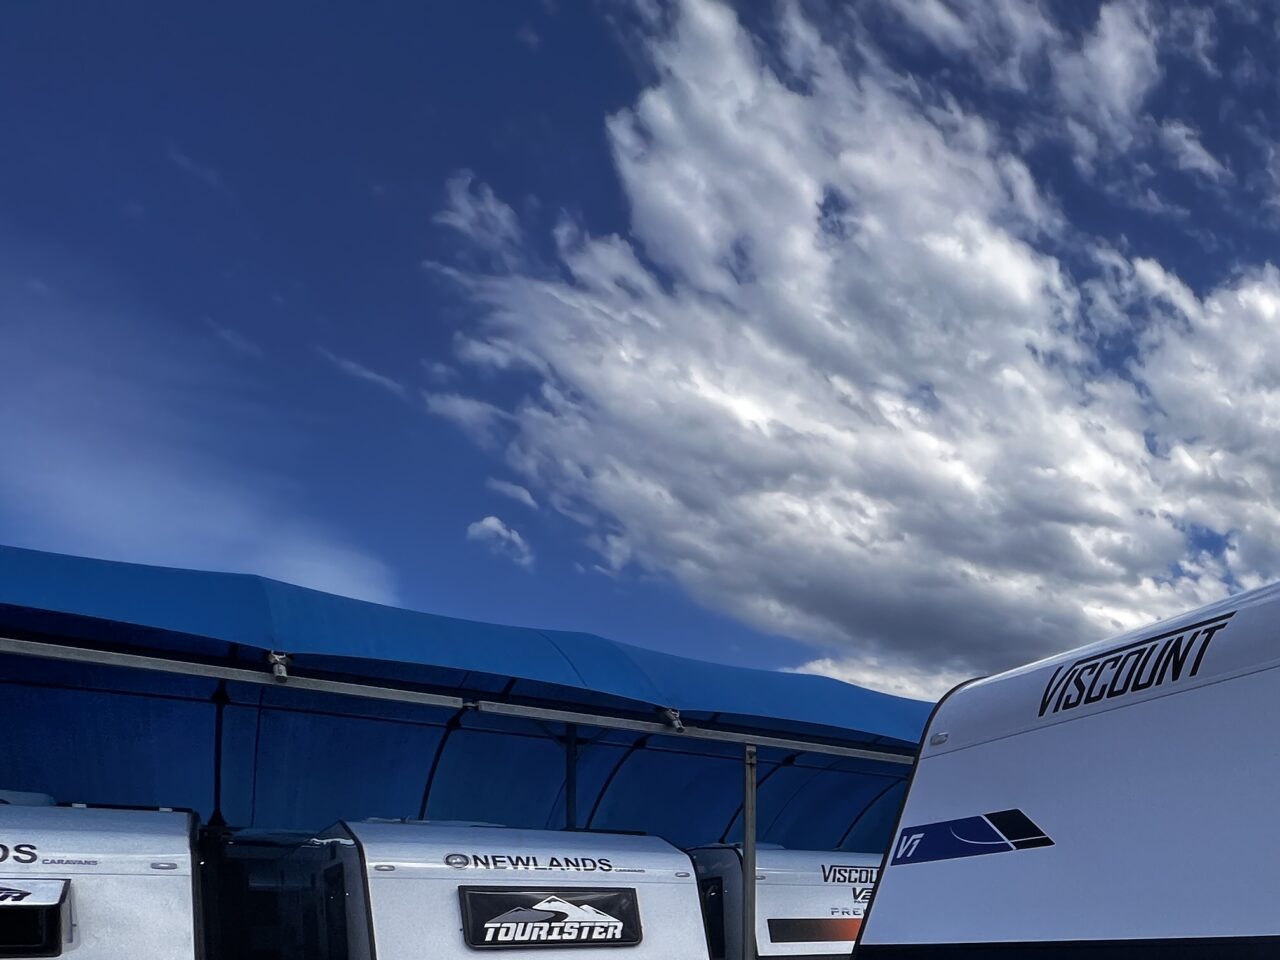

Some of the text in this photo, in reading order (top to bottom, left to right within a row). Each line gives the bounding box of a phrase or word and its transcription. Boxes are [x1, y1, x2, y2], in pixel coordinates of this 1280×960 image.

[1038, 610, 1238, 718] VISCOUNT
[42, 858, 98, 866] CARAVANS
[472, 853, 613, 872] NEWLANDS
[821, 865, 880, 883] VISCOU
[484, 921, 623, 942] TOURISTER
